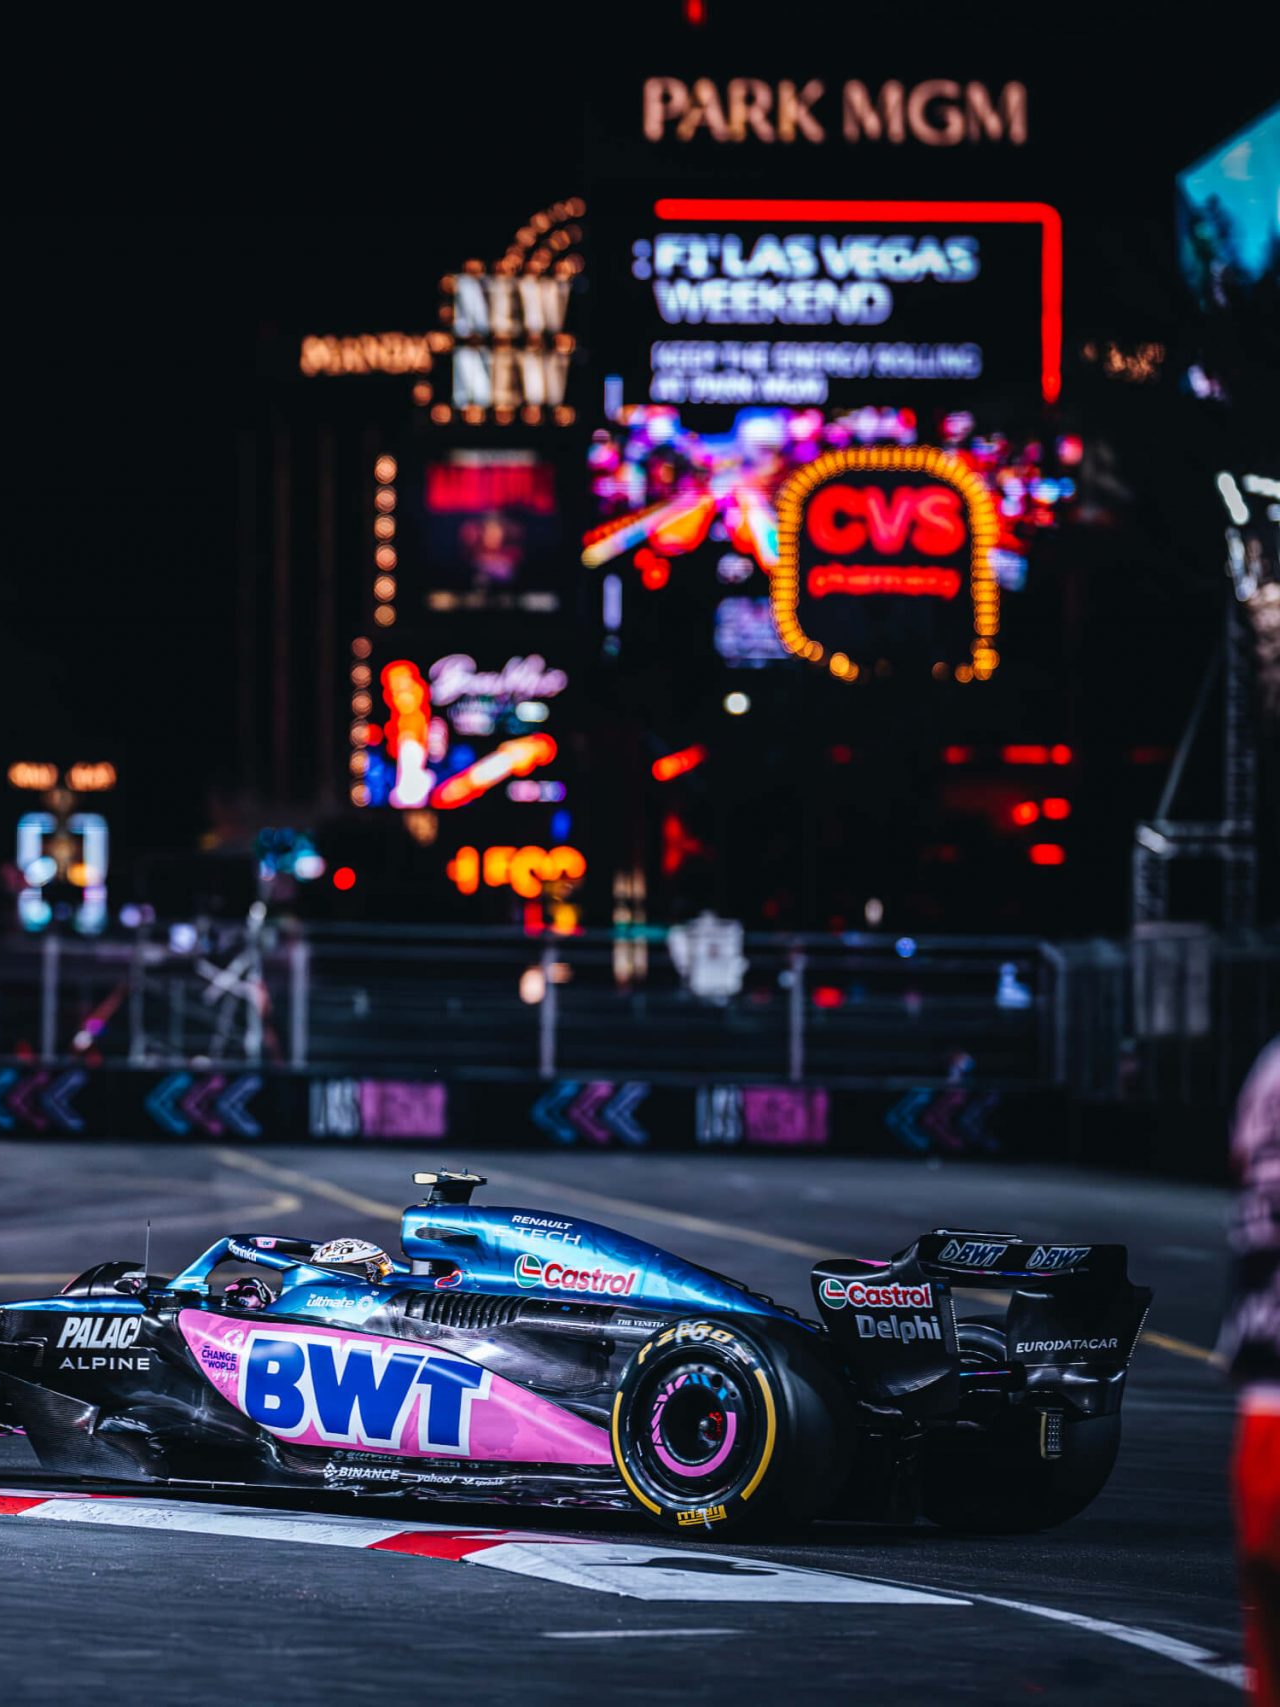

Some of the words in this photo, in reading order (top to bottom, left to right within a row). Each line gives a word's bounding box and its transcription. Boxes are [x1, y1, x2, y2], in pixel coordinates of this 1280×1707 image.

[642, 76, 826, 144] PARK
[842, 79, 1028, 147] MGM
[721, 233, 819, 280] LAS
[821, 235, 980, 282] VEGAS
[653, 279, 894, 325] WEEKEND
[807, 484, 967, 557] CVS
[511, 1214, 574, 1230] RENAULT
[956, 1243, 1008, 1267] BWT
[1041, 1246, 1092, 1270] BWT
[543, 1261, 637, 1296] Castrol
[846, 1281, 933, 1309] Castrol
[56, 1316, 142, 1349] PALAC
[633, 1320, 669, 1328] VENETIA
[854, 1314, 942, 1344] Delphi
[201, 1349, 238, 1362] CHANGE
[1016, 1337, 1118, 1353] EURODATACAR
[59, 1356, 151, 1371] ALPINE
[208, 1360, 236, 1371] WORLD
[239, 1331, 493, 1456] BWT
[338, 1467, 400, 1480] BINANCE
[677, 1504, 728, 1527] PIRELLI
